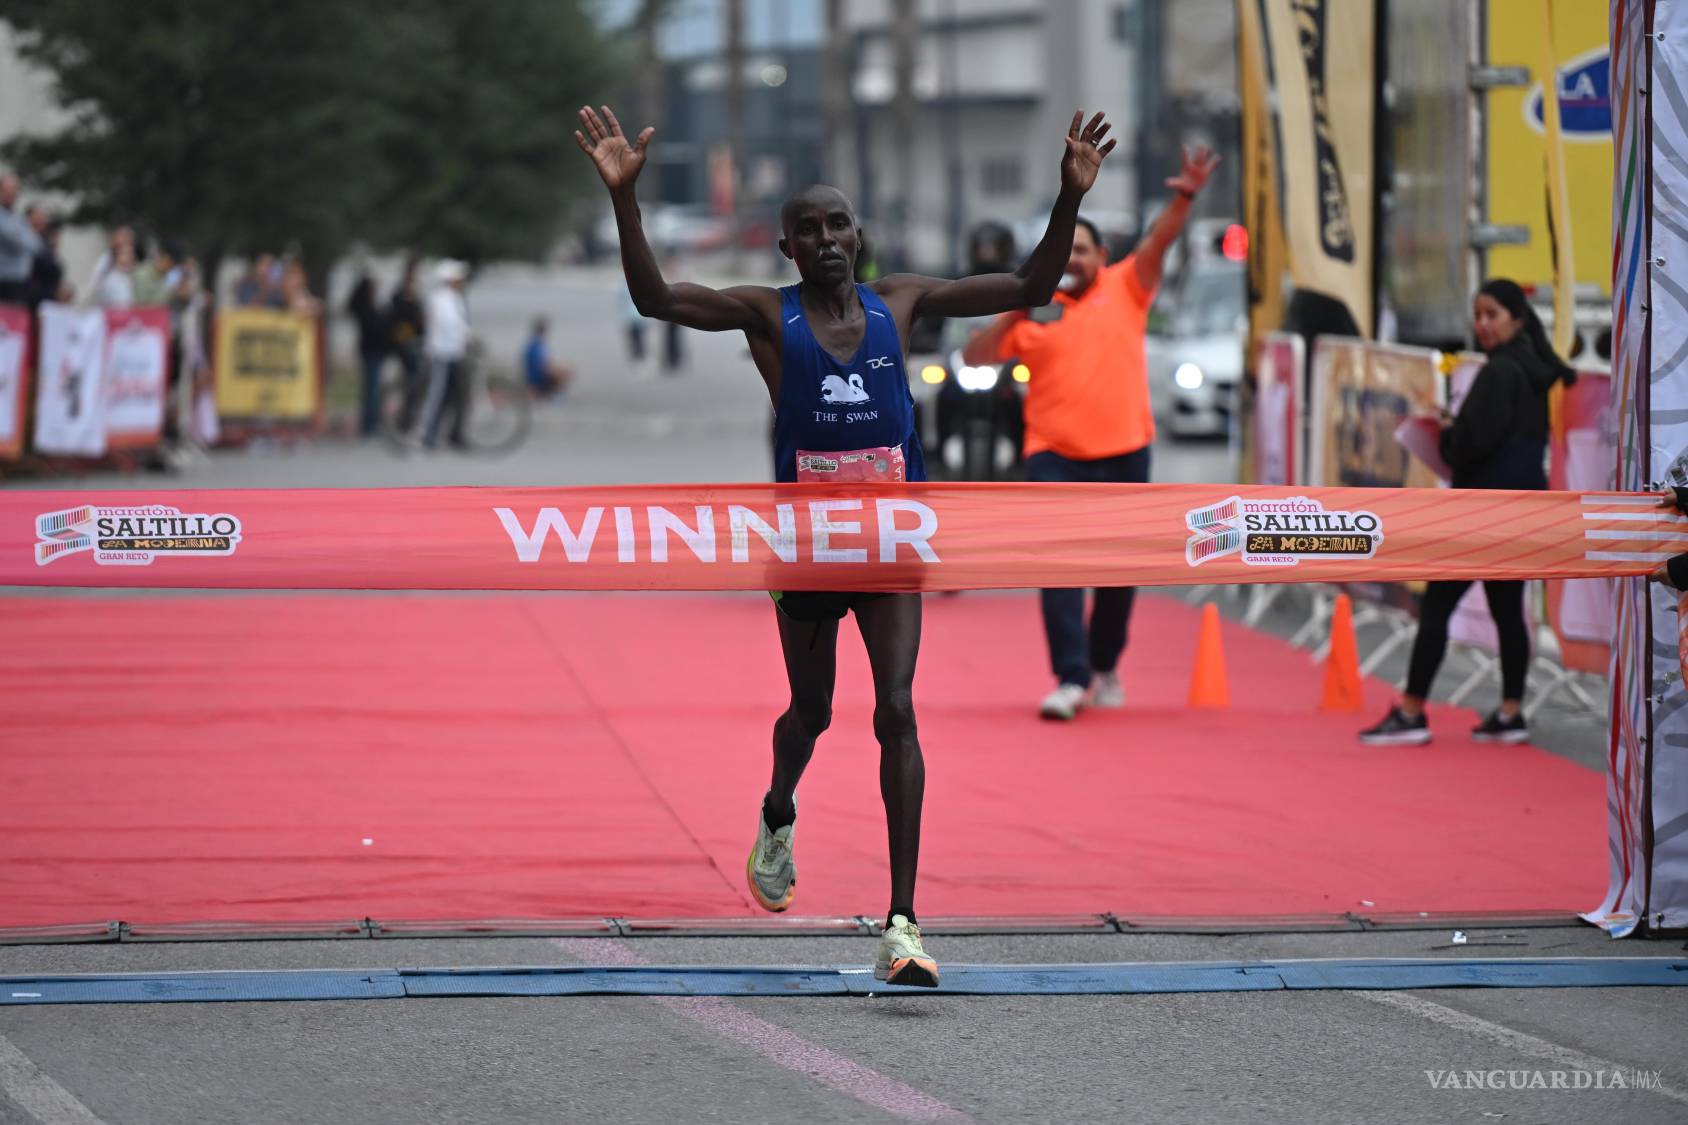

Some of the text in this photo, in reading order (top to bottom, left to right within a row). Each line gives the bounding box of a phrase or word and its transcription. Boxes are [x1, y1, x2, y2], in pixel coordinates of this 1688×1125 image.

[846, 410, 878, 423] SWAN
[98, 505, 176, 516] maratón
[1244, 500, 1319, 513] maratón
[97, 517, 236, 537] SALTILLO
[1245, 514, 1377, 532] SALTILLO
[492, 498, 942, 564] WINNER
[1249, 537, 1369, 551] LA MODERNA
[100, 552, 149, 561] GRAN RETO
